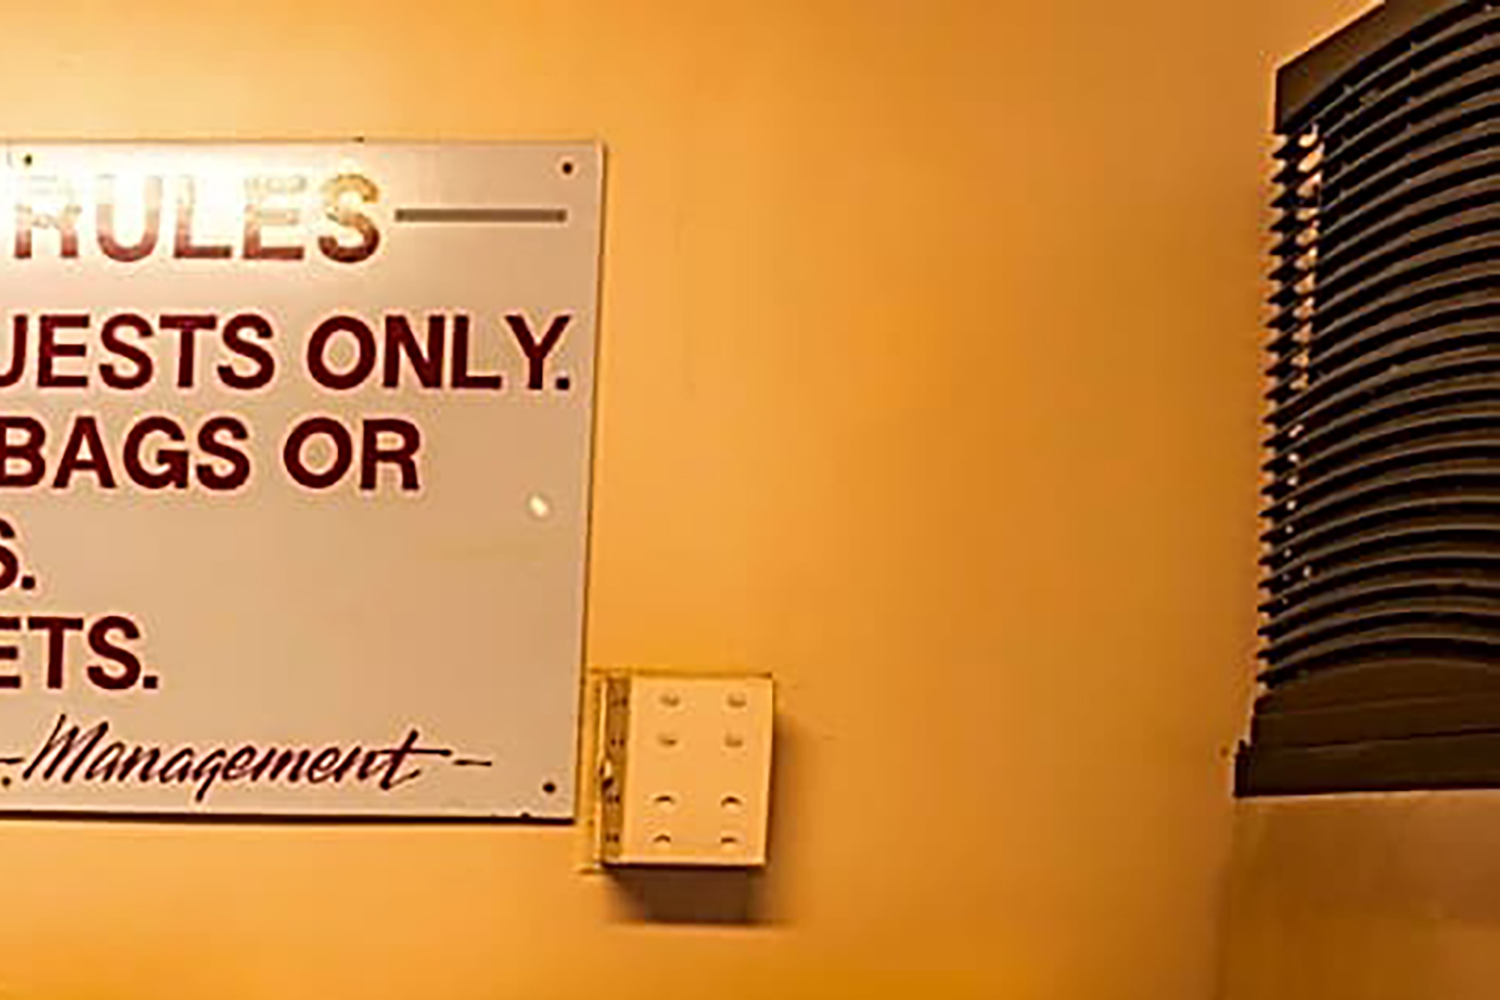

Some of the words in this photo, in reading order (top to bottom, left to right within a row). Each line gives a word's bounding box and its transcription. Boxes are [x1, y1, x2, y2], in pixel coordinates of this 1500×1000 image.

[13, 172, 382, 265] RULES
[305, 313, 573, 392] ONLY.
[281, 415, 422, 492] OR
[22, 712, 454, 804] Management
